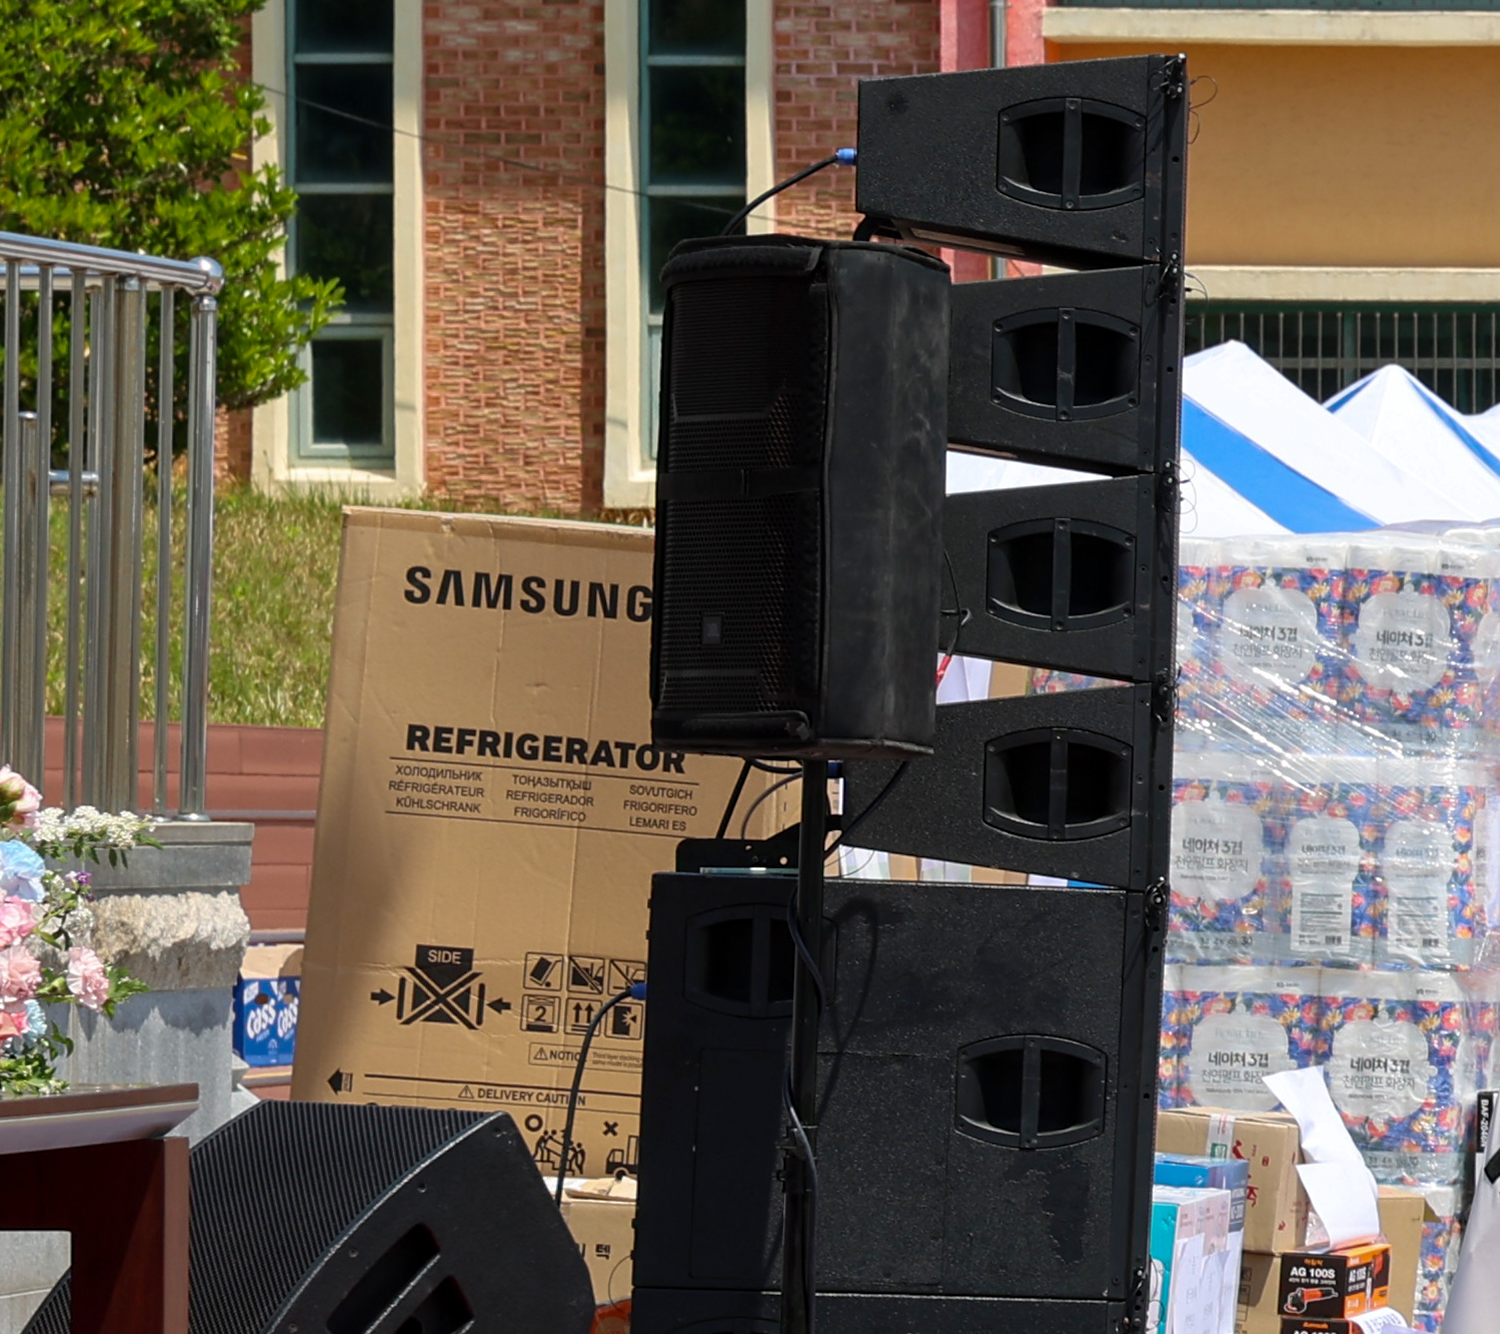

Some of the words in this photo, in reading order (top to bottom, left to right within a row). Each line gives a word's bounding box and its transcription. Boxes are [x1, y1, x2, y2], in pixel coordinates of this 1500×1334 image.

[404, 565, 653, 623] SAMSUNG
[1376, 630, 1413, 647] 네이처
[405, 723, 686, 774] REFRIGERATOR
[395, 764, 483, 782] ХОЛОДИЛЬНИК
[388, 779, 485, 798] RÉFRIGÉRATEUR
[629, 784, 693, 800] SOVUTGICH
[396, 795, 482, 814] KÜHLSCHRANK
[506, 789, 594, 807] REFRIGERADOR
[513, 805, 587, 823] FRIGORÍFICO
[623, 799, 698, 817] FRIGORIFERO
[629, 816, 670, 831] LEMARI
[672, 819, 687, 832] ES
[1182, 837, 1219, 854] 네이처
[1220, 840, 1243, 855] 3겹
[428, 948, 462, 965] SIDE
[534, 1005, 547, 1023] 2
[1207, 1051, 1246, 1067] 네이처
[1247, 1053, 1269, 1068] 3겹
[1350, 1056, 1388, 1073] 네이처
[1389, 1058, 1411, 1074] 3겹
[1243, 1069, 1275, 1085] 화장
[477, 1087, 534, 1103] DELIVERY
[536, 1090, 586, 1106] CAUTIN
[1290, 1267, 1307, 1277] AG
[1309, 1268, 1336, 1279] 100S
